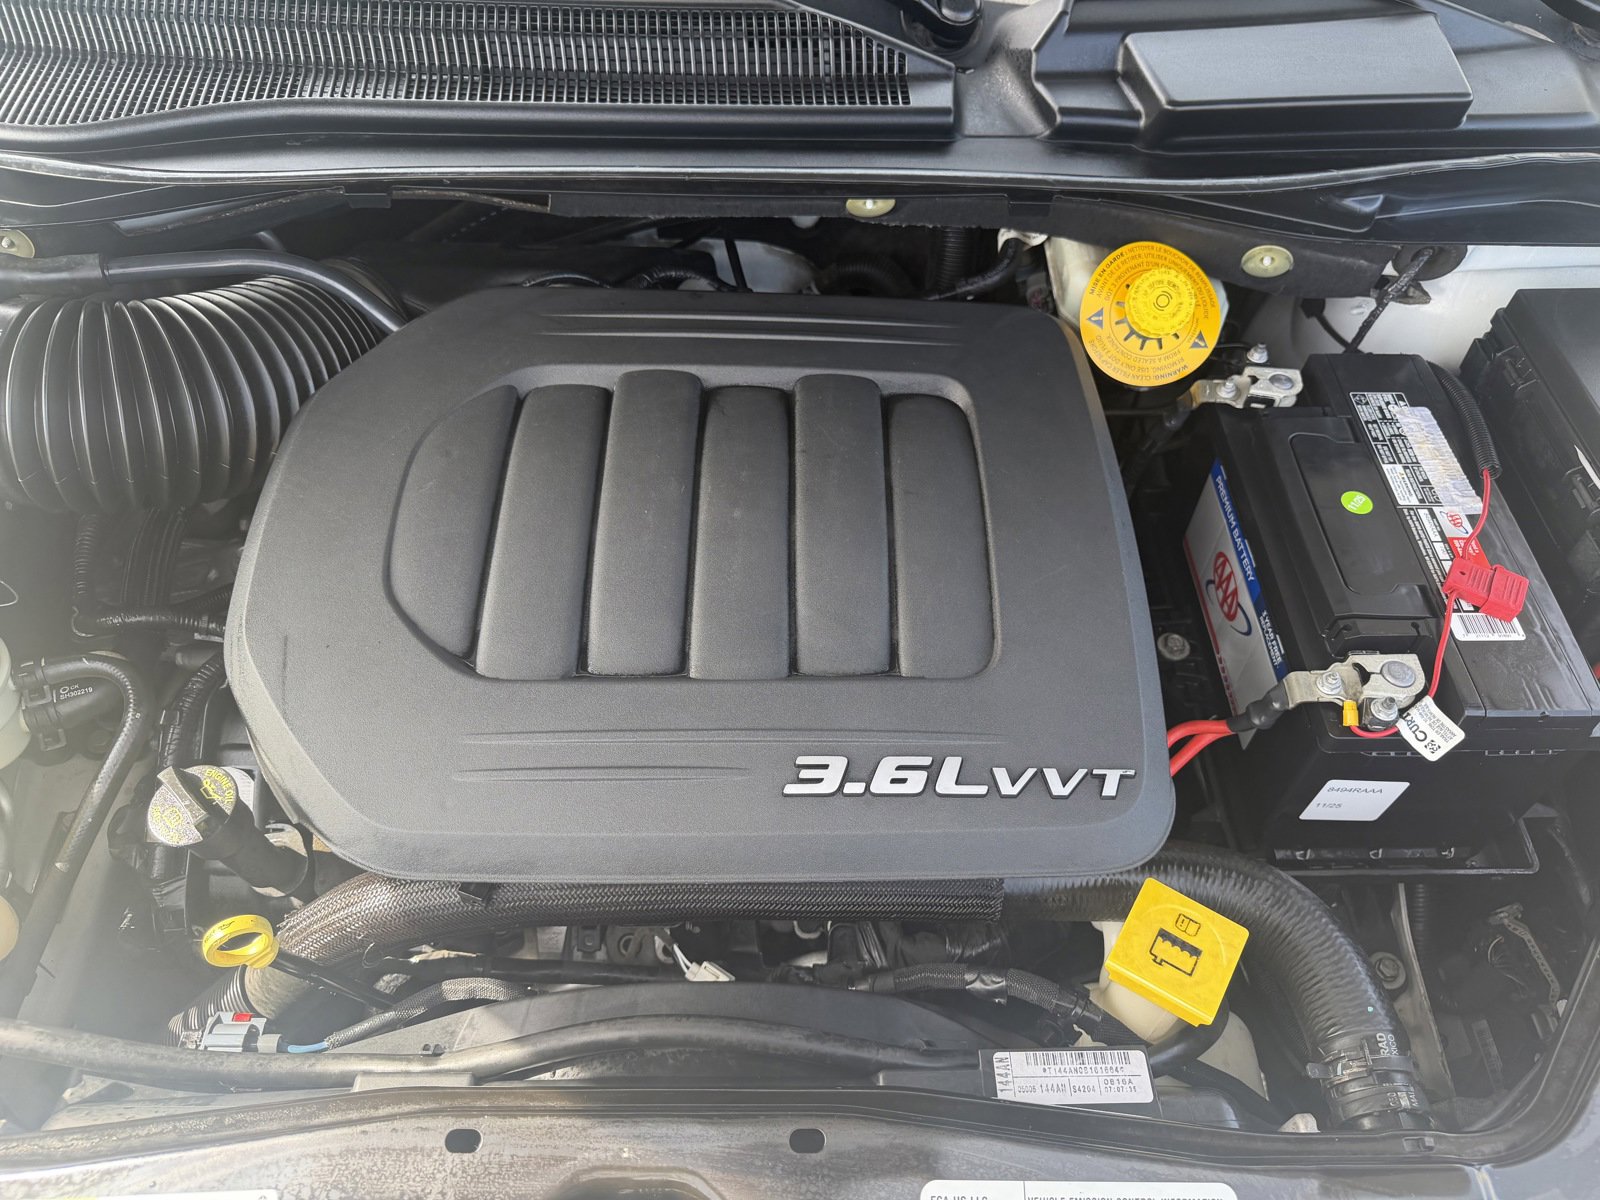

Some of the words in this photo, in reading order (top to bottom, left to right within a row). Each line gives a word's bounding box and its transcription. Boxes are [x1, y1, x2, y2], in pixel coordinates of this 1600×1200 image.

[1096, 267, 1106, 278] EN
[1214, 474, 1236, 528] PREMIUM
[1231, 527, 1255, 580] BATTERY
[1215, 556, 1239, 621] AAA
[59, 687, 93, 700] SH302219
[204, 768, 232, 789] ENGINE
[224, 789, 235, 804] OIL
[783, 755, 990, 796] 3.6L
[991, 767, 1136, 799] VVT
[1326, 786, 1383, 794] 8494RAAA
[1388, 1034, 1399, 1056] XICO
[995, 1057, 1013, 1093] 144AN
